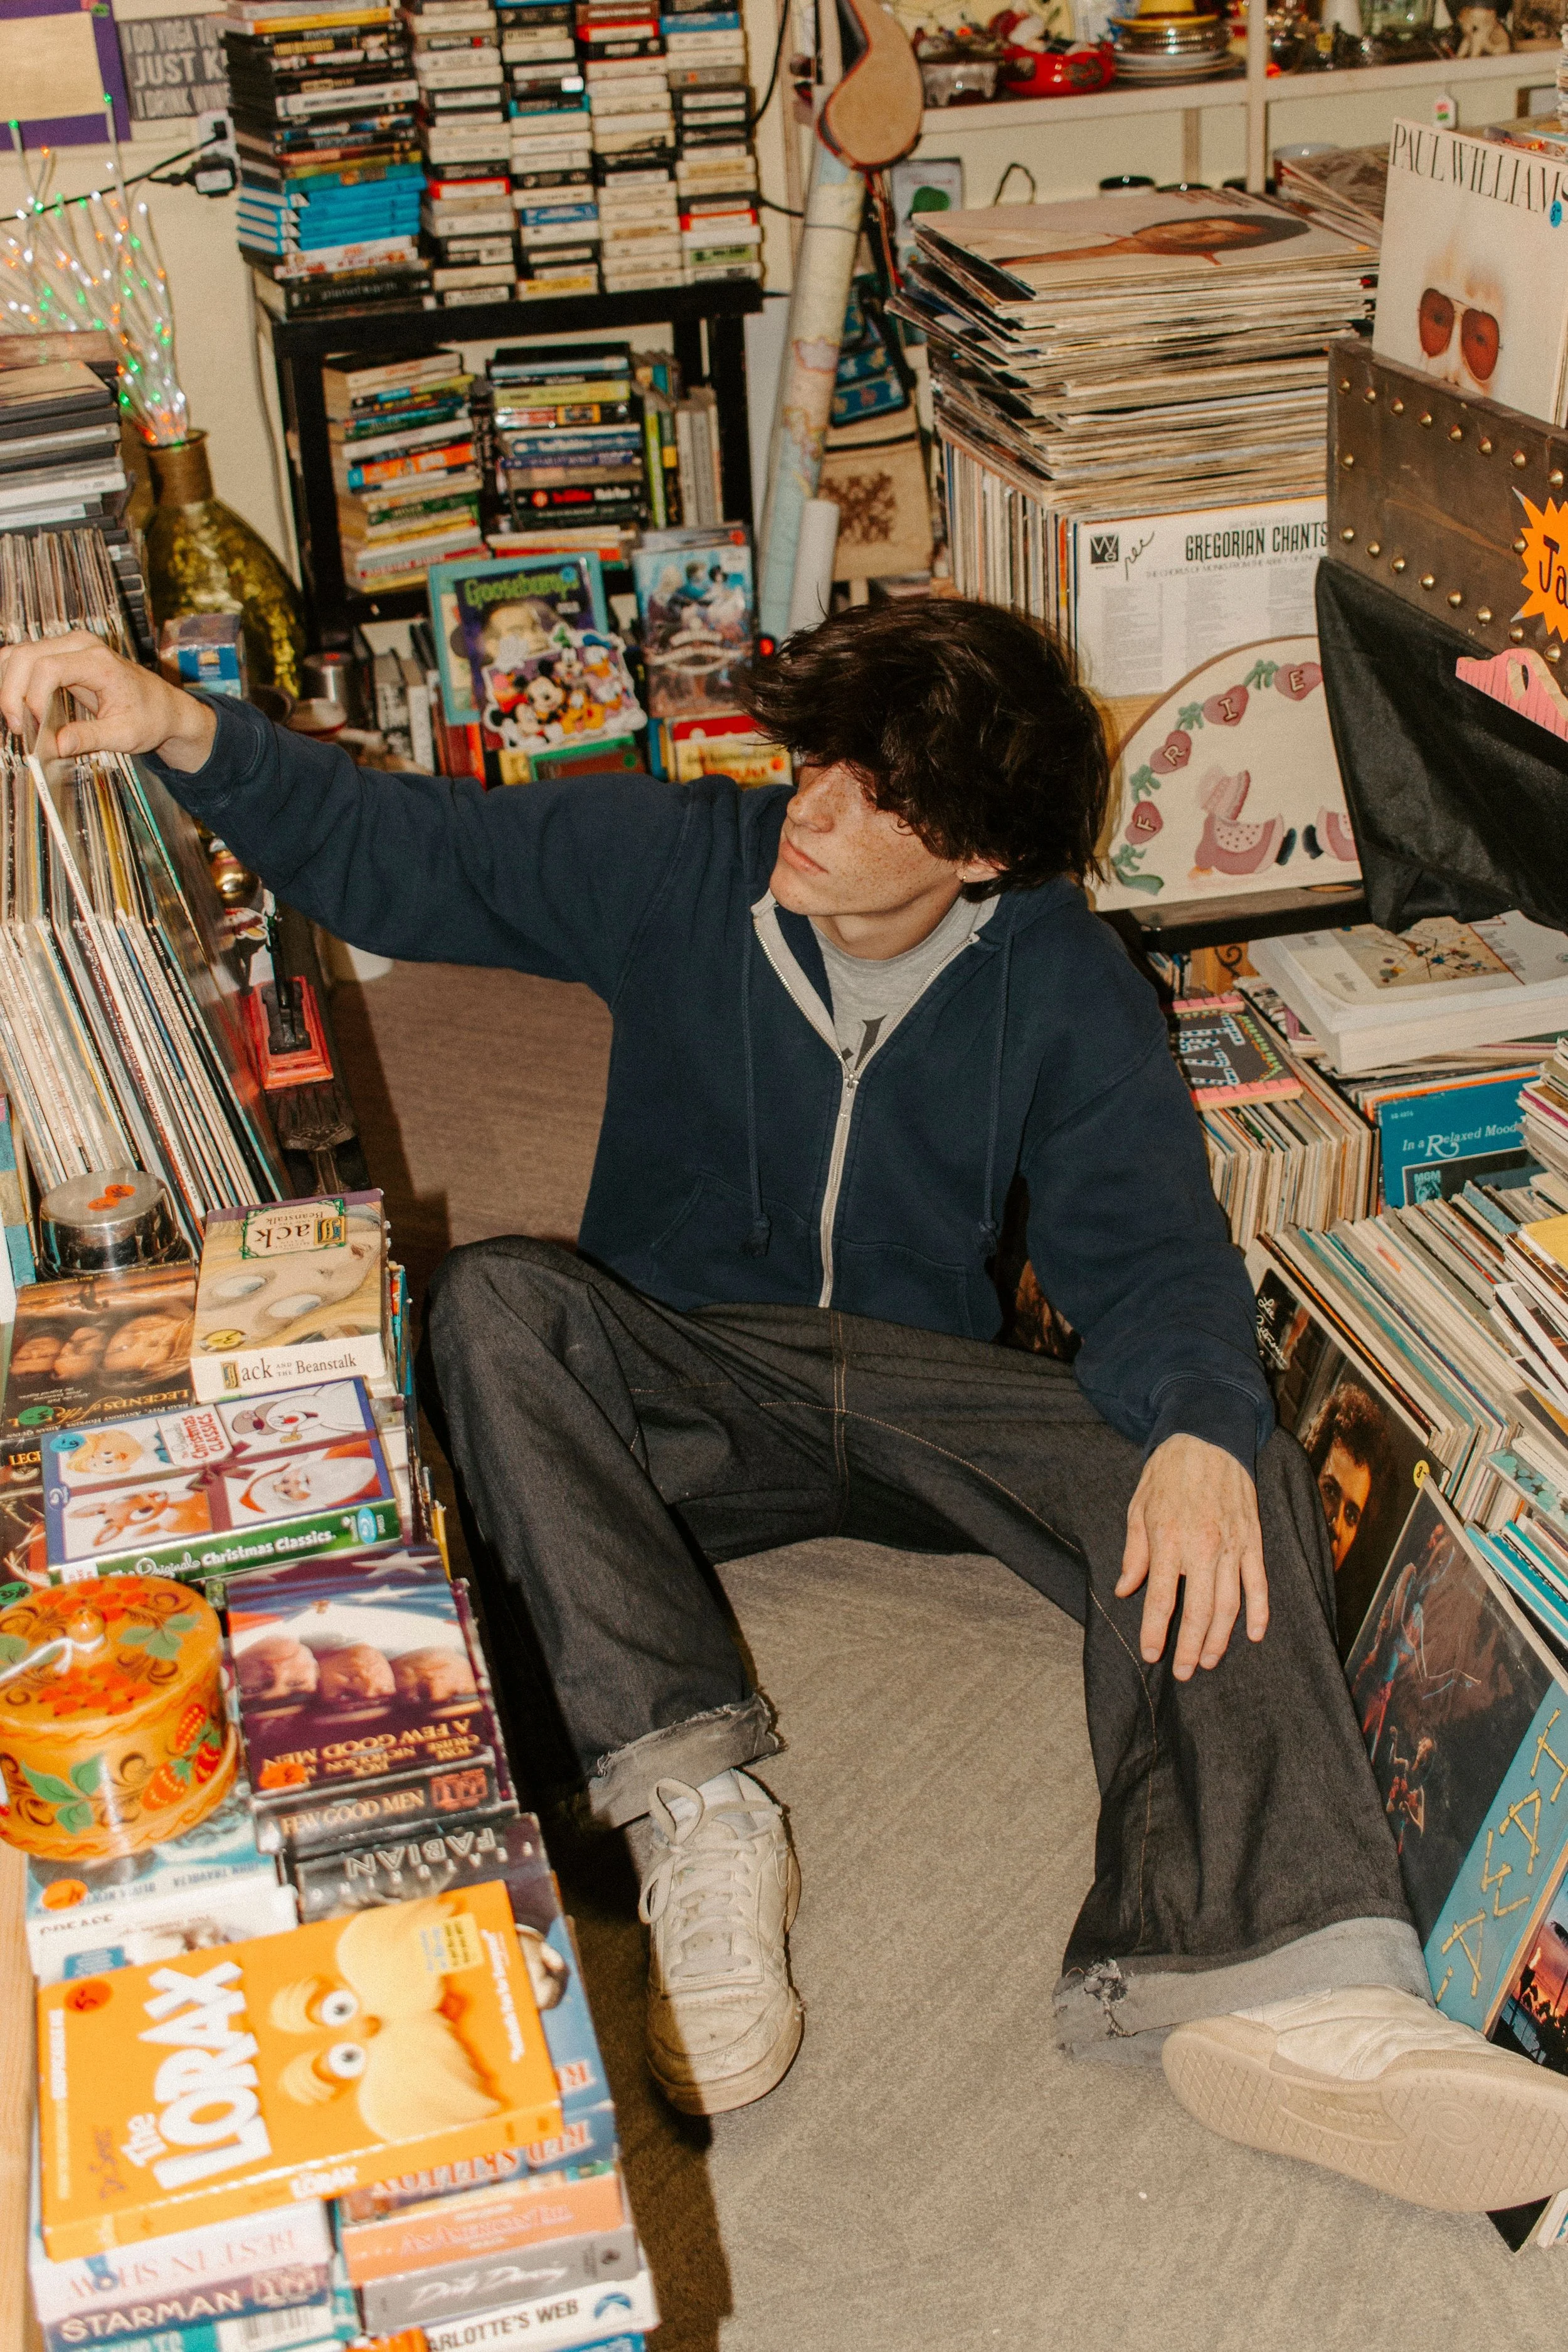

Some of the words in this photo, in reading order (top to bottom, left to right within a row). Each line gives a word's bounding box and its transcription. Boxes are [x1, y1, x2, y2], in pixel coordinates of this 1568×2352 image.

[134, 51, 196, 88] JUST
[1389, 123, 1445, 181] PAUL
[1186, 527, 1264, 563] GREGORIAN
[1273, 521, 1328, 554] CHANTS
[60, 842, 72, 859] GYPSY
[83, 904, 92, 915] AND
[87, 914, 95, 925] HIS
[90, 924, 107, 953] ORCHESTRA
[127, 968, 139, 985] WANT
[135, 988, 143, 997] TO
[147, 975, 158, 993] MILLER
[154, 993, 162, 1004] AND
[92, 1001, 103, 1022] BENNY
[99, 1023, 117, 1054] GOODMAN
[115, 1064, 130, 1090] MOSCOW
[184, 1036, 199, 1062] GOODMAN
[145, 1069, 157, 1089] LONDON
[152, 1089, 162, 1104] PHASE
[159, 1108, 171, 1127] STEREO
[171, 1139, 186, 1167] STEREO
[1402, 1139, 1415, 1152] In
[1417, 1140, 1425, 1149] a
[1424, 1126, 1482, 1158] Relaxed
[1414, 1168, 1441, 1182] MGM
[265, 1210, 323, 1224] Beanstalk
[220, 1357, 273, 1391] Jack
[296, 1353, 358, 1374] Beanstalk
[104, 1386, 189, 1412] LEGENDS
[34, 1424, 61, 1434] AIDAN
[65, 1416, 101, 1428] HOPKINS
[102, 1409, 141, 1422] ANTHONY
[6, 1428, 33, 1439] QUINN
[180, 1414, 209, 1461] Christmas
[196, 1411, 225, 1454] CLASSICS
[136, 1552, 199, 1579] Original
[201, 1541, 274, 1569] Christmas
[400, 1722, 452, 1743] FEW
[452, 1717, 472, 1735] A
[261, 1746, 317, 1770] MEN
[321, 1732, 397, 1759] GOOD
[281, 1806, 324, 1834] FEW
[322, 1798, 379, 1825] GOOD
[380, 1788, 425, 1815] MEN
[341, 1826, 497, 1881] FABIAN
[136, 1959, 273, 2190] LORAX
[120, 2112, 168, 2168] The
[290, 2165, 359, 2200] LORAX
[60, 2289, 243, 2343] STARMAN
[534, 2298, 580, 2324] WEB
